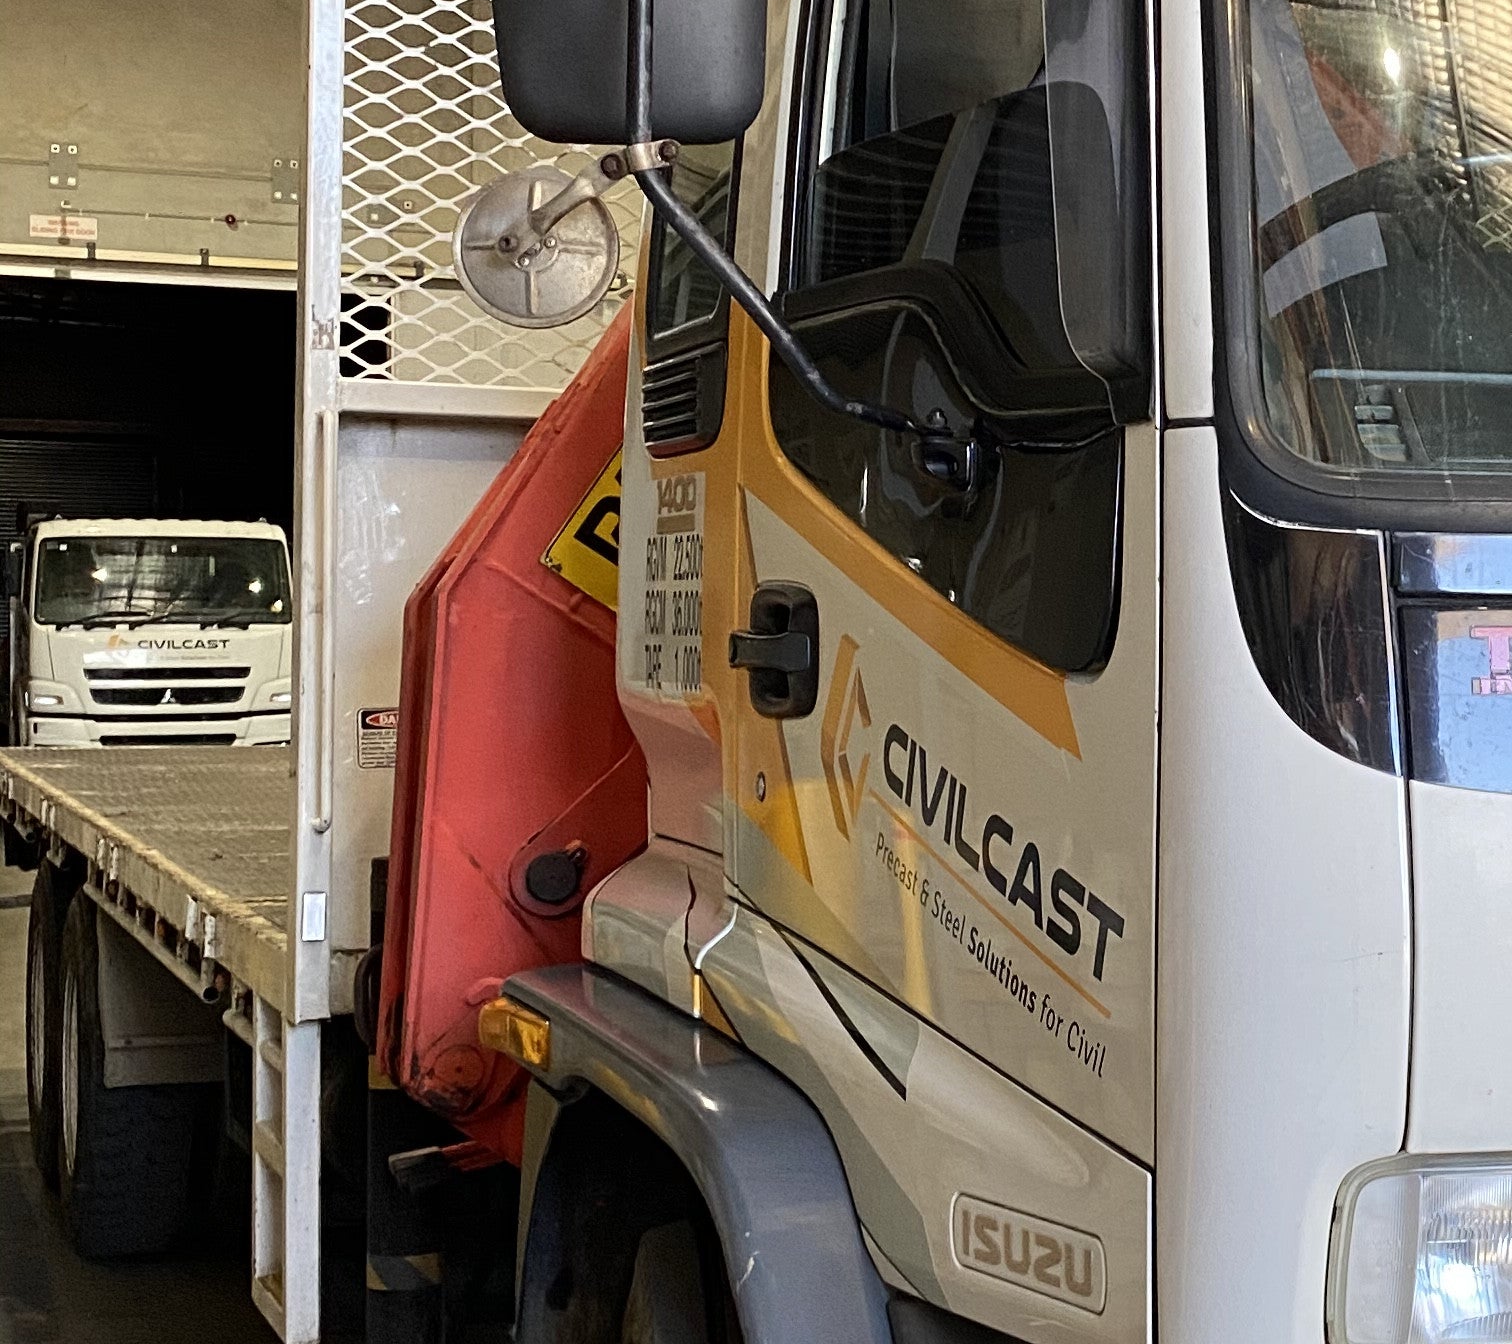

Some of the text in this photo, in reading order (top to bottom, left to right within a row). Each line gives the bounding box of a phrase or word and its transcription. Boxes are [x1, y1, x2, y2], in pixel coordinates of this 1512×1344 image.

[657, 474, 697, 515] 1400
[138, 639, 231, 650] CIVILCAST
[883, 723, 1125, 982] CIVILCAST
[875, 831, 1107, 1078] Precast & Steel Solutions for Civil
[962, 1209, 1093, 1298] ISUZU
